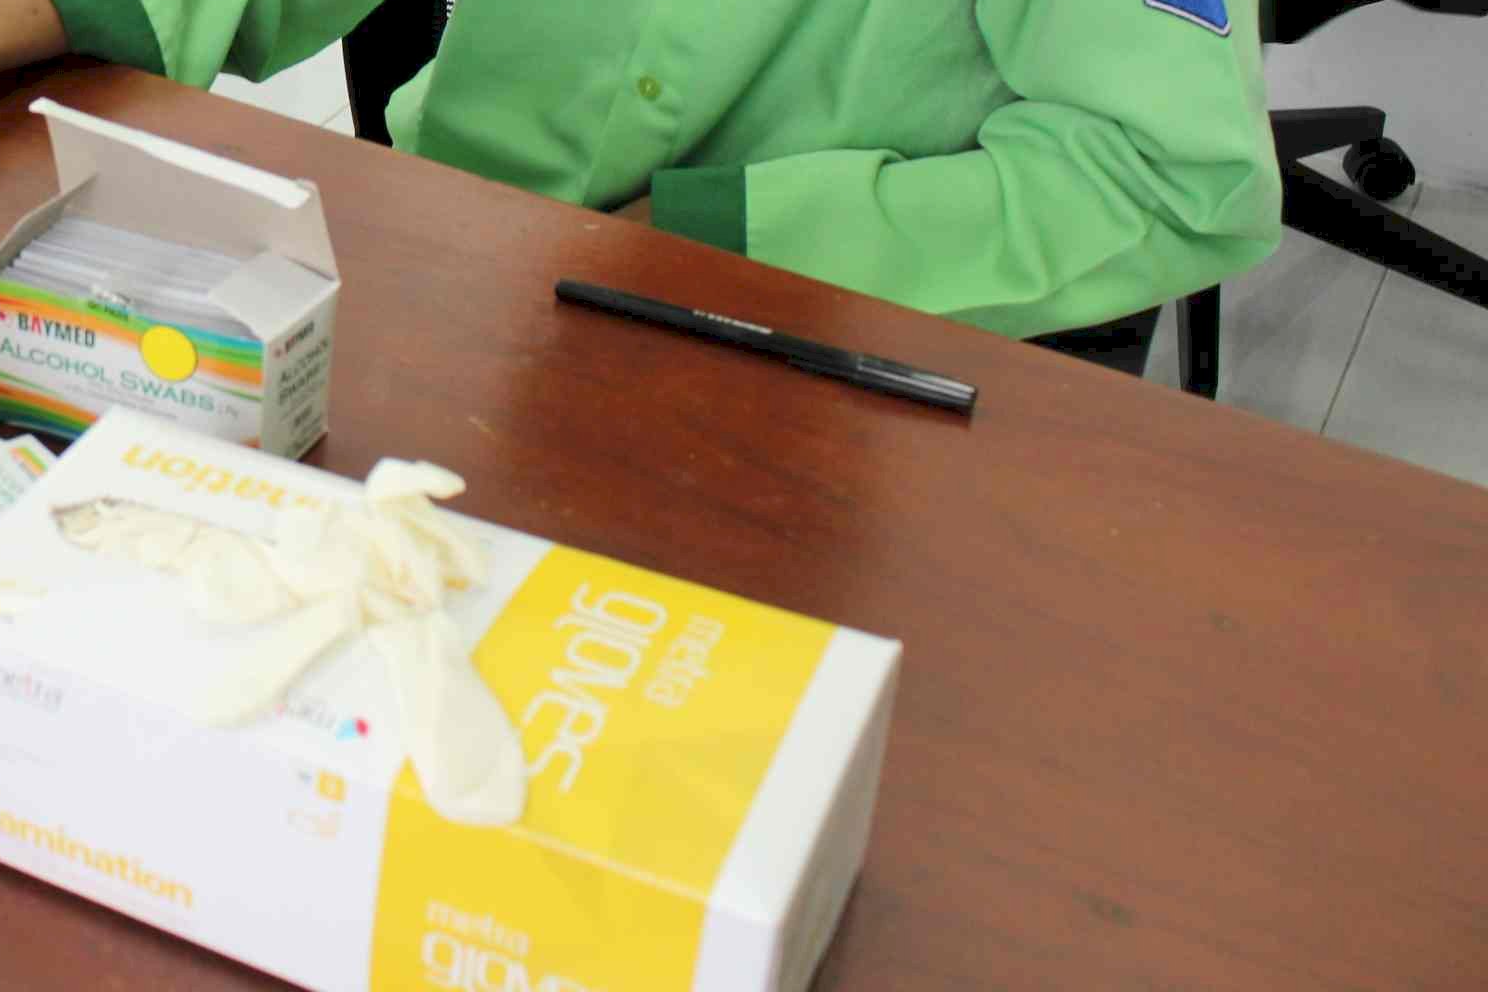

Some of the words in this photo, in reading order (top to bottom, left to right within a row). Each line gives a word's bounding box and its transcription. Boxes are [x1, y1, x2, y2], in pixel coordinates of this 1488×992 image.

[17, 311, 97, 349] BAYMED
[0, 337, 115, 385] ALCOHOL
[119, 368, 216, 413] SWABS
[521, 580, 668, 795] gloves
